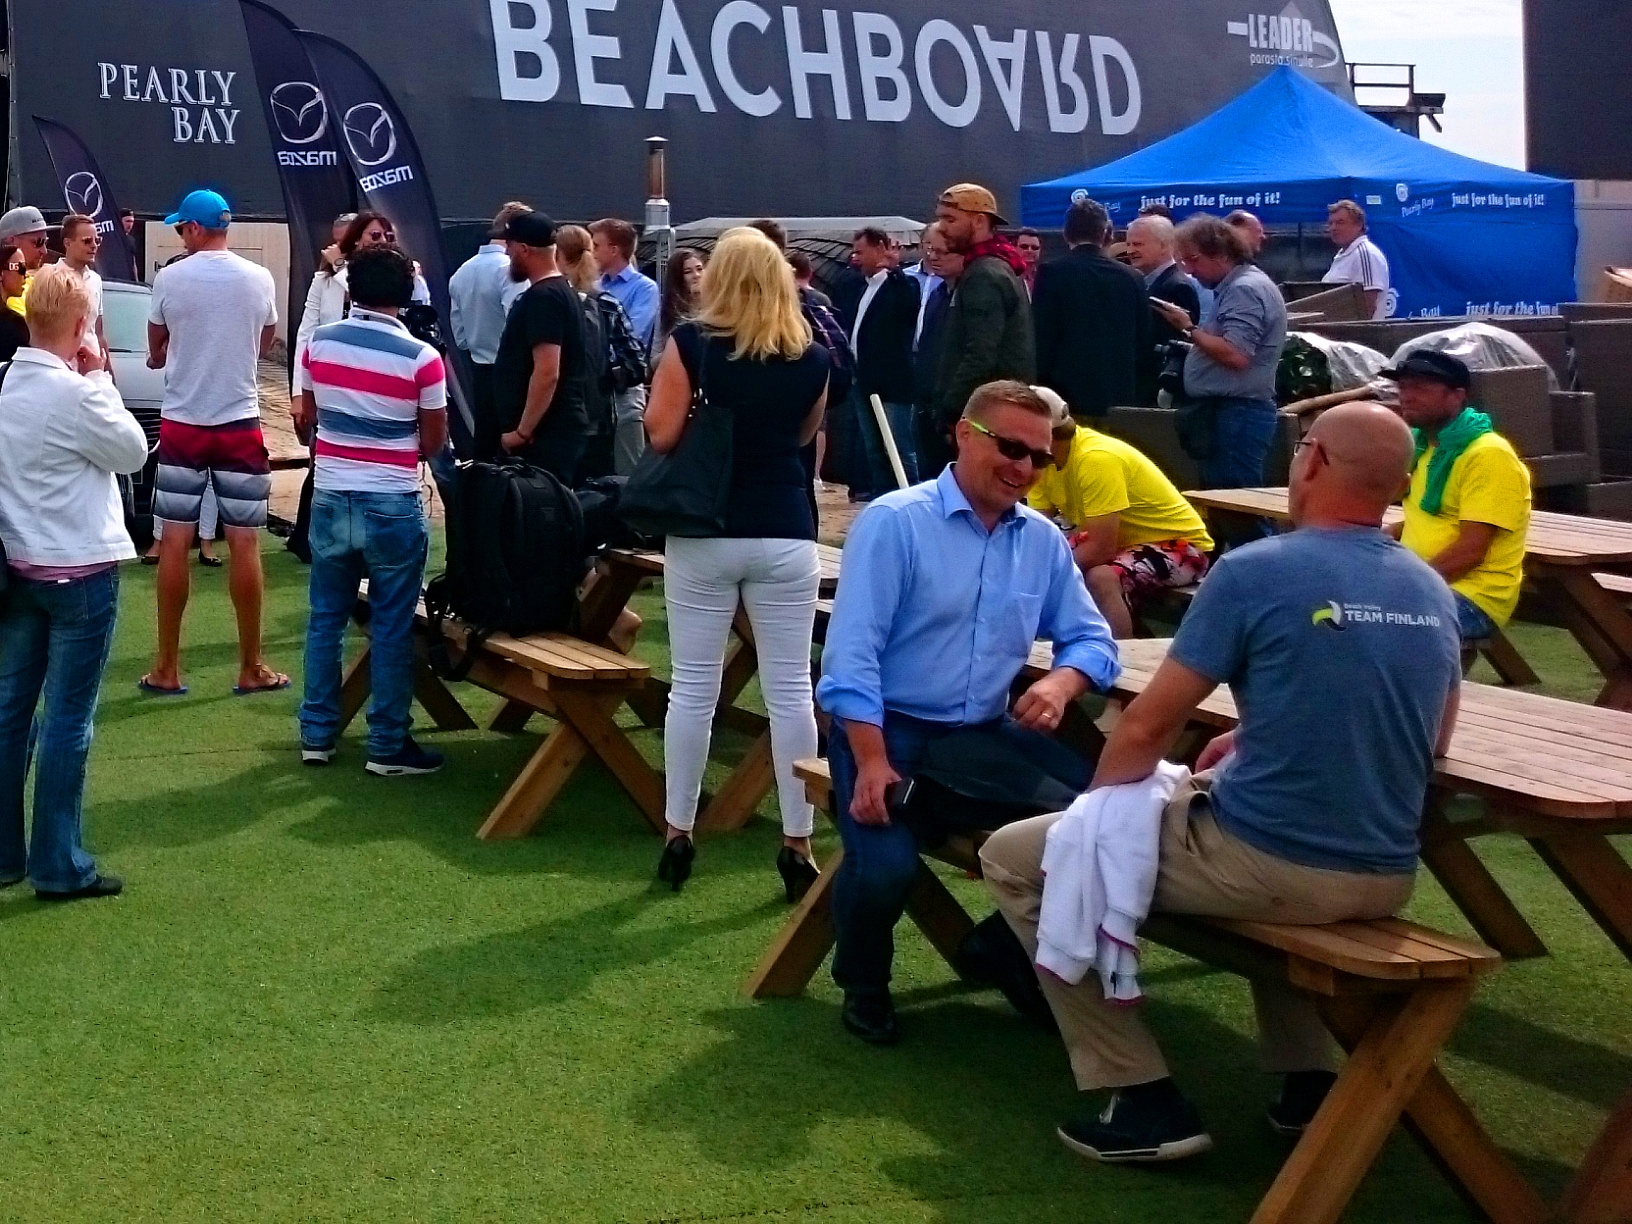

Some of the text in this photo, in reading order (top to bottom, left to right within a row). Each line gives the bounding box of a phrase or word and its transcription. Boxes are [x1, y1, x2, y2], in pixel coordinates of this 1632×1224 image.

[1248, 13, 1314, 52] LEADER
[97, 62, 237, 106] PEARLY
[171, 106, 241, 144] BAY
[1168, 194, 1190, 209] for
[1193, 193, 1215, 206] the
[1218, 193, 1243, 208] fun
[1246, 191, 1261, 207] of
[1264, 191, 1280, 205] it!
[1451, 192, 1469, 207] just
[1471, 192, 1486, 207] for
[1488, 193, 1503, 206] the
[1505, 193, 1521, 208] fun
[1523, 193, 1533, 208] of
[1345, 610, 1440, 628] TEAM FINLAND
